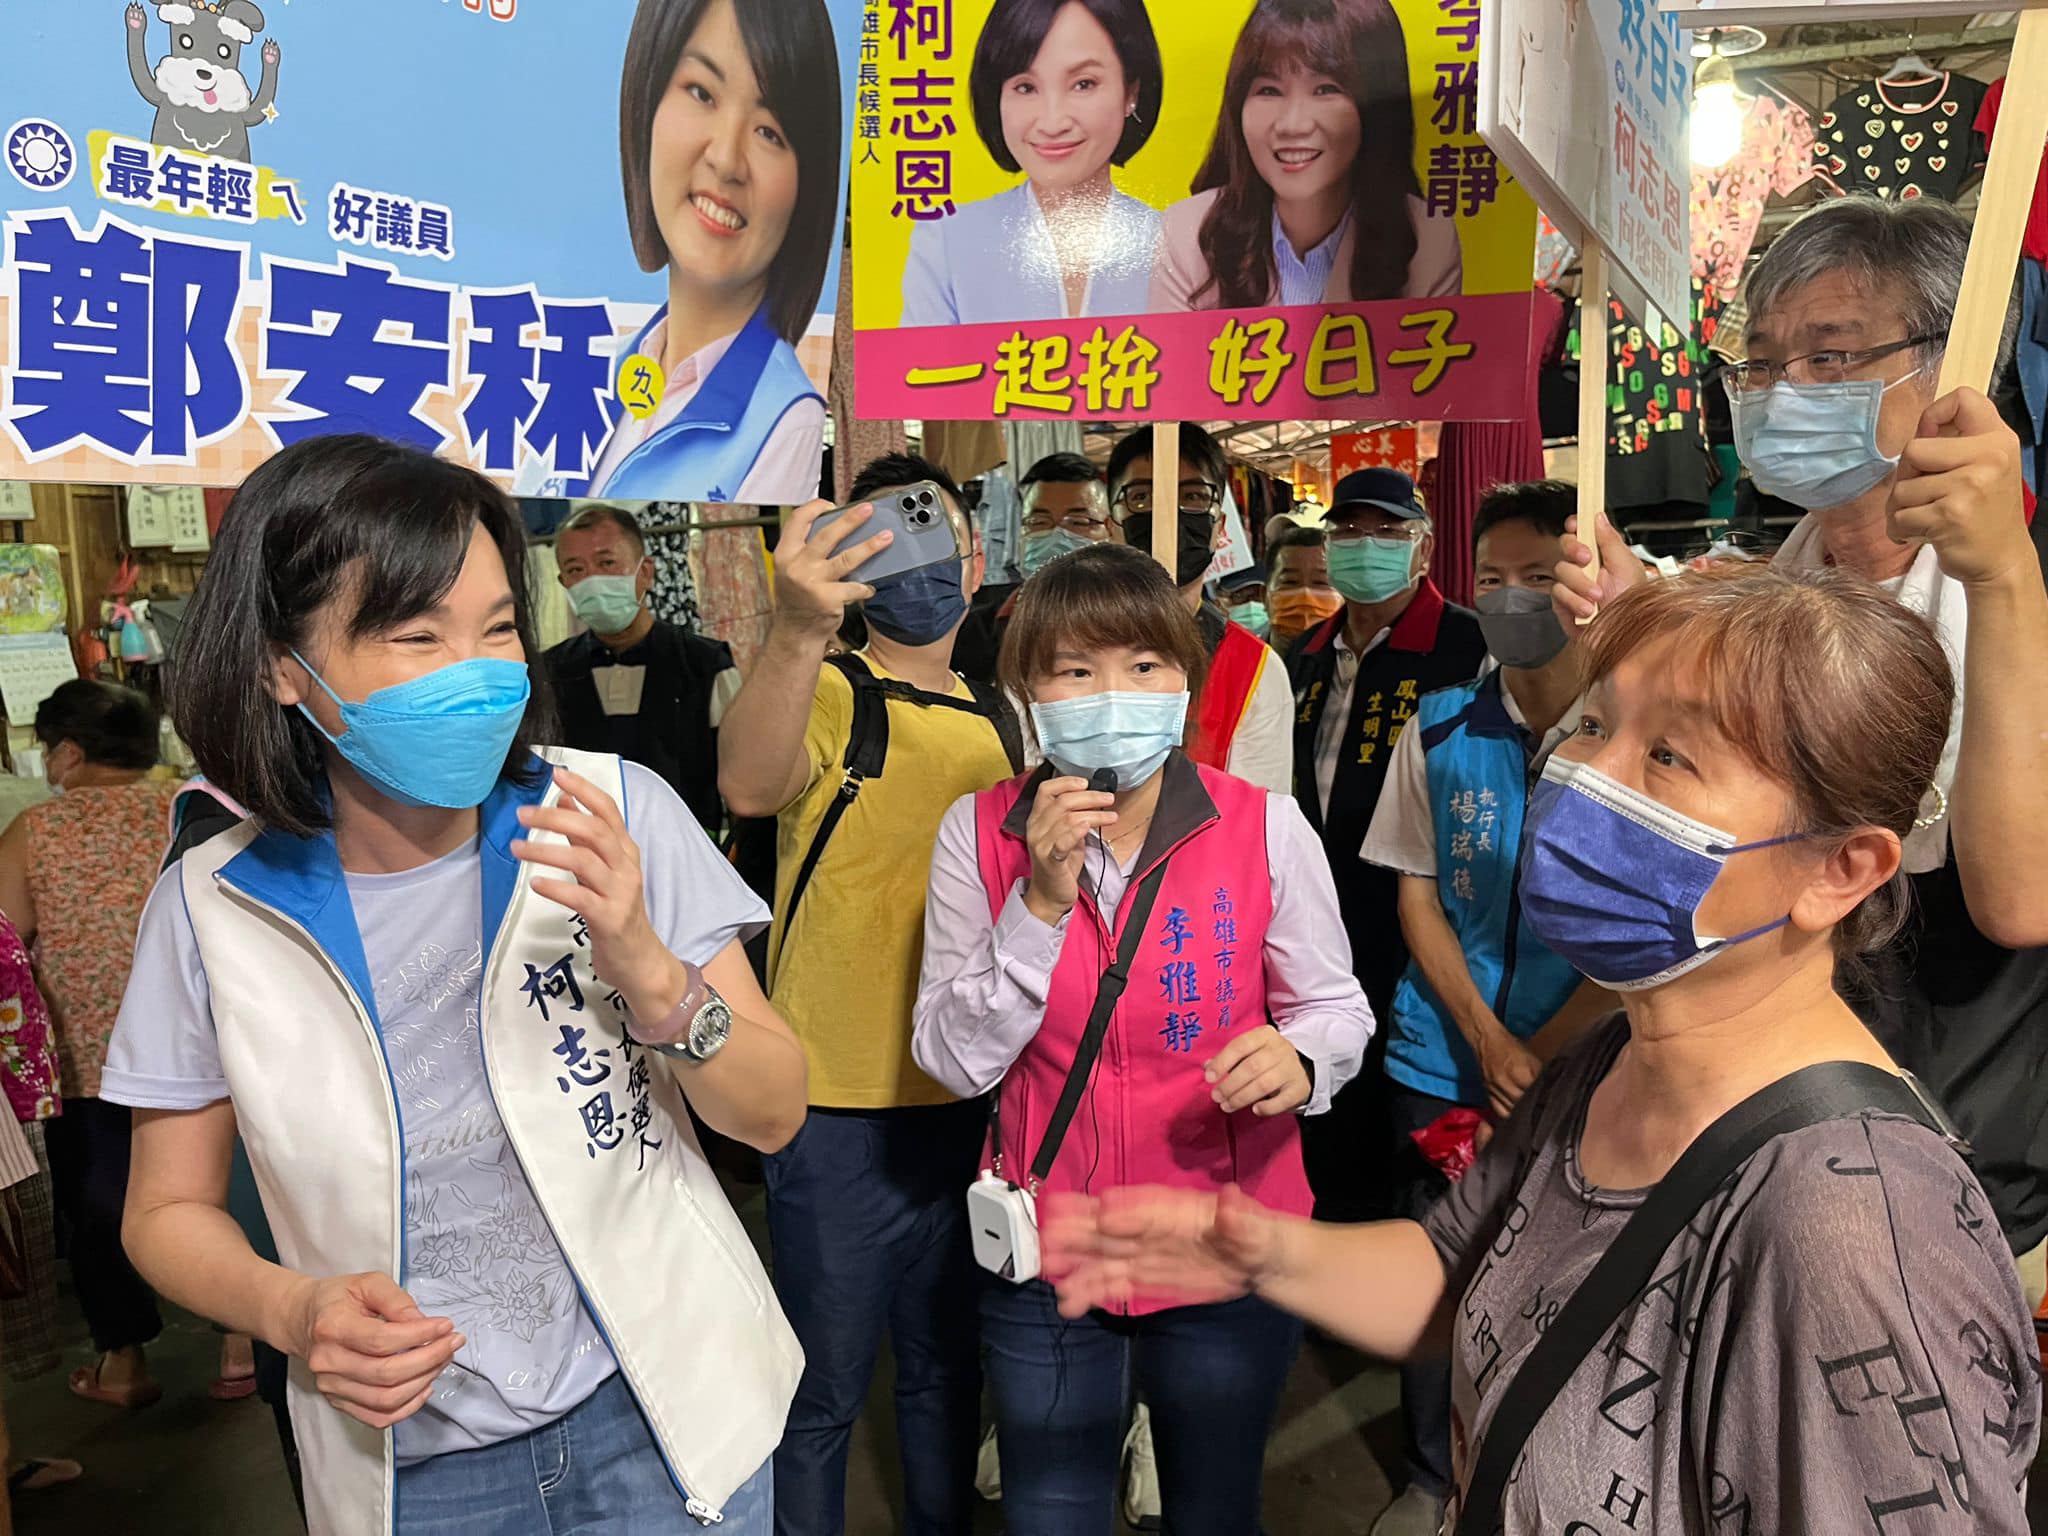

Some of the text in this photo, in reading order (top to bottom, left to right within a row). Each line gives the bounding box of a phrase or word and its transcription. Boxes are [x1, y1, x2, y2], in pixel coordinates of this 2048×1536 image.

[888, 0, 957, 221] 柯志恩
[333, 188, 452, 255] 好議員
[1614, 101, 1683, 256] 柯志恩
[1208, 307, 1473, 405] 好日子
[1357, 691, 1383, 764] 生明里
[1477, 786, 1498, 852] 執行長
[1158, 906, 1203, 1053] 李雅靜
[1212, 887, 1239, 1031] 高雄市議員
[519, 952, 626, 1160] 柯志恩
[1600, 1468, 1650, 1532] H
